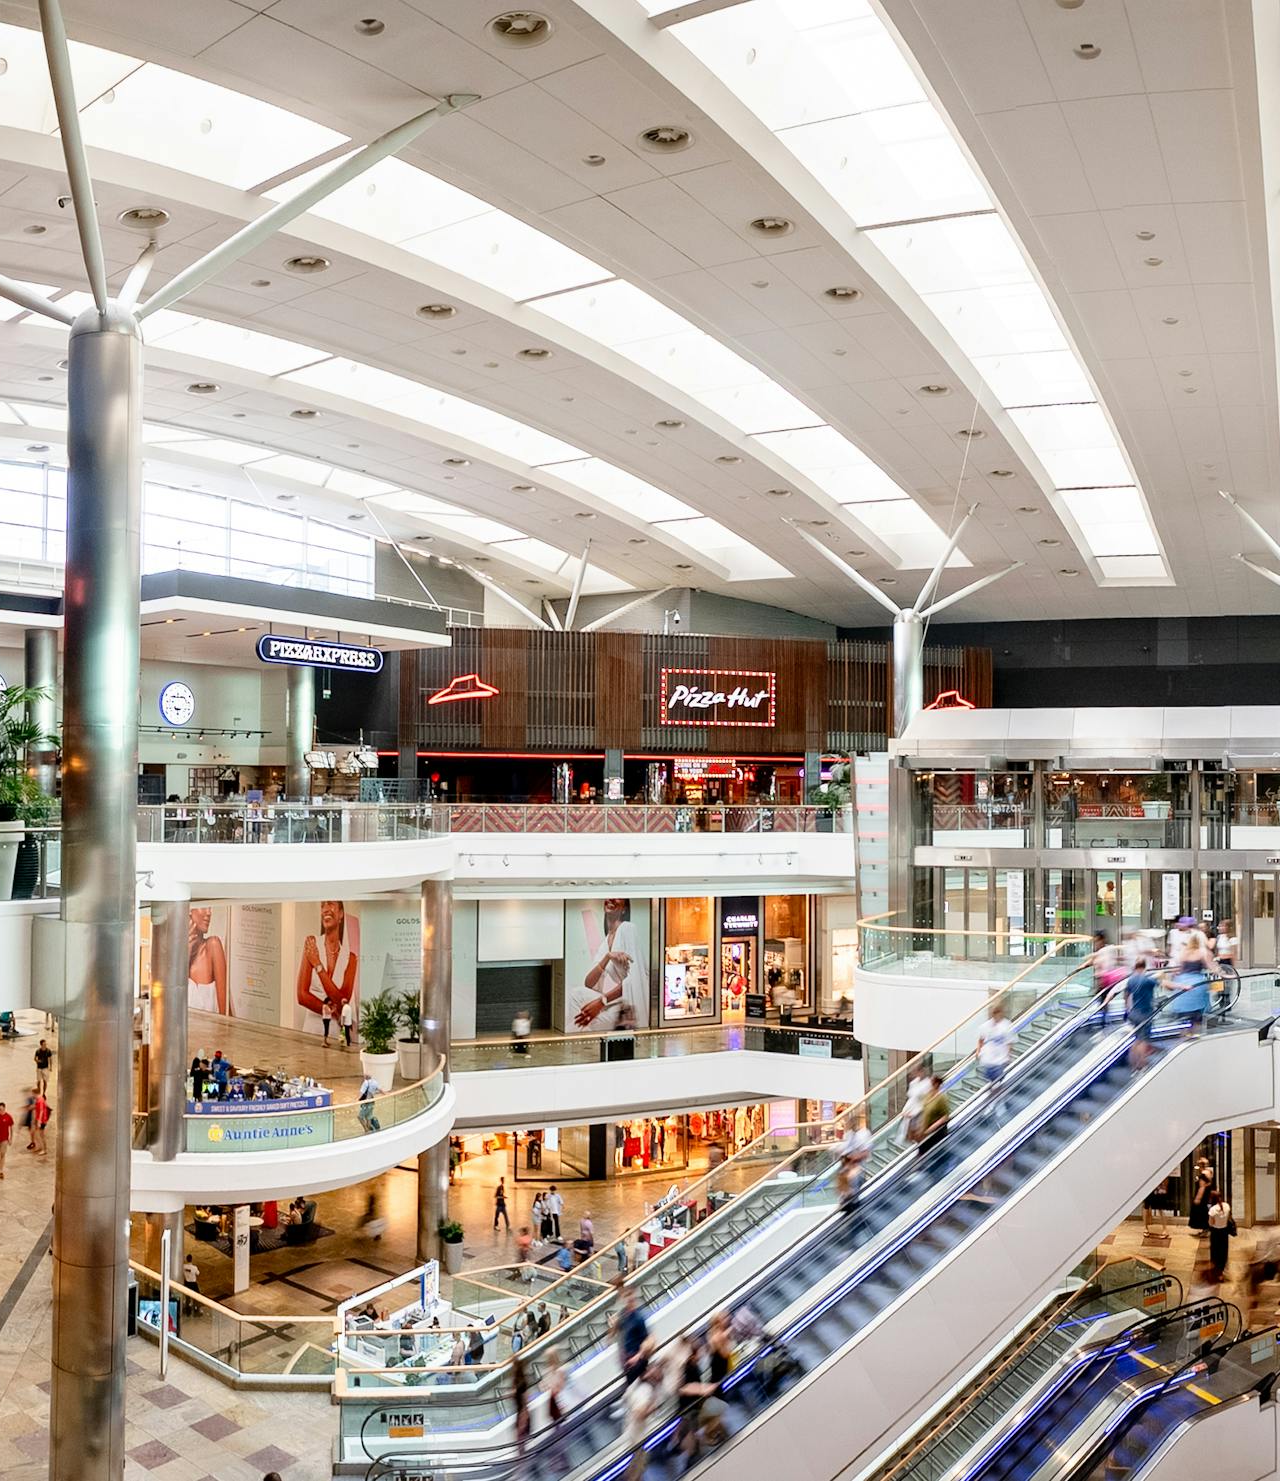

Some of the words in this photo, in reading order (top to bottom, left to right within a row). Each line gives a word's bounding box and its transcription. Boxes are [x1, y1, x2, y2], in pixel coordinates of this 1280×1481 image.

[269, 640, 376, 668] PIZZAEXPRESS
[668, 685, 726, 709] Pizza
[727, 686, 771, 709] Hut
[242, 905, 273, 914] GOLDSMITHS
[224, 1127, 271, 1141] Auntie
[272, 1124, 314, 1138] Anne's
